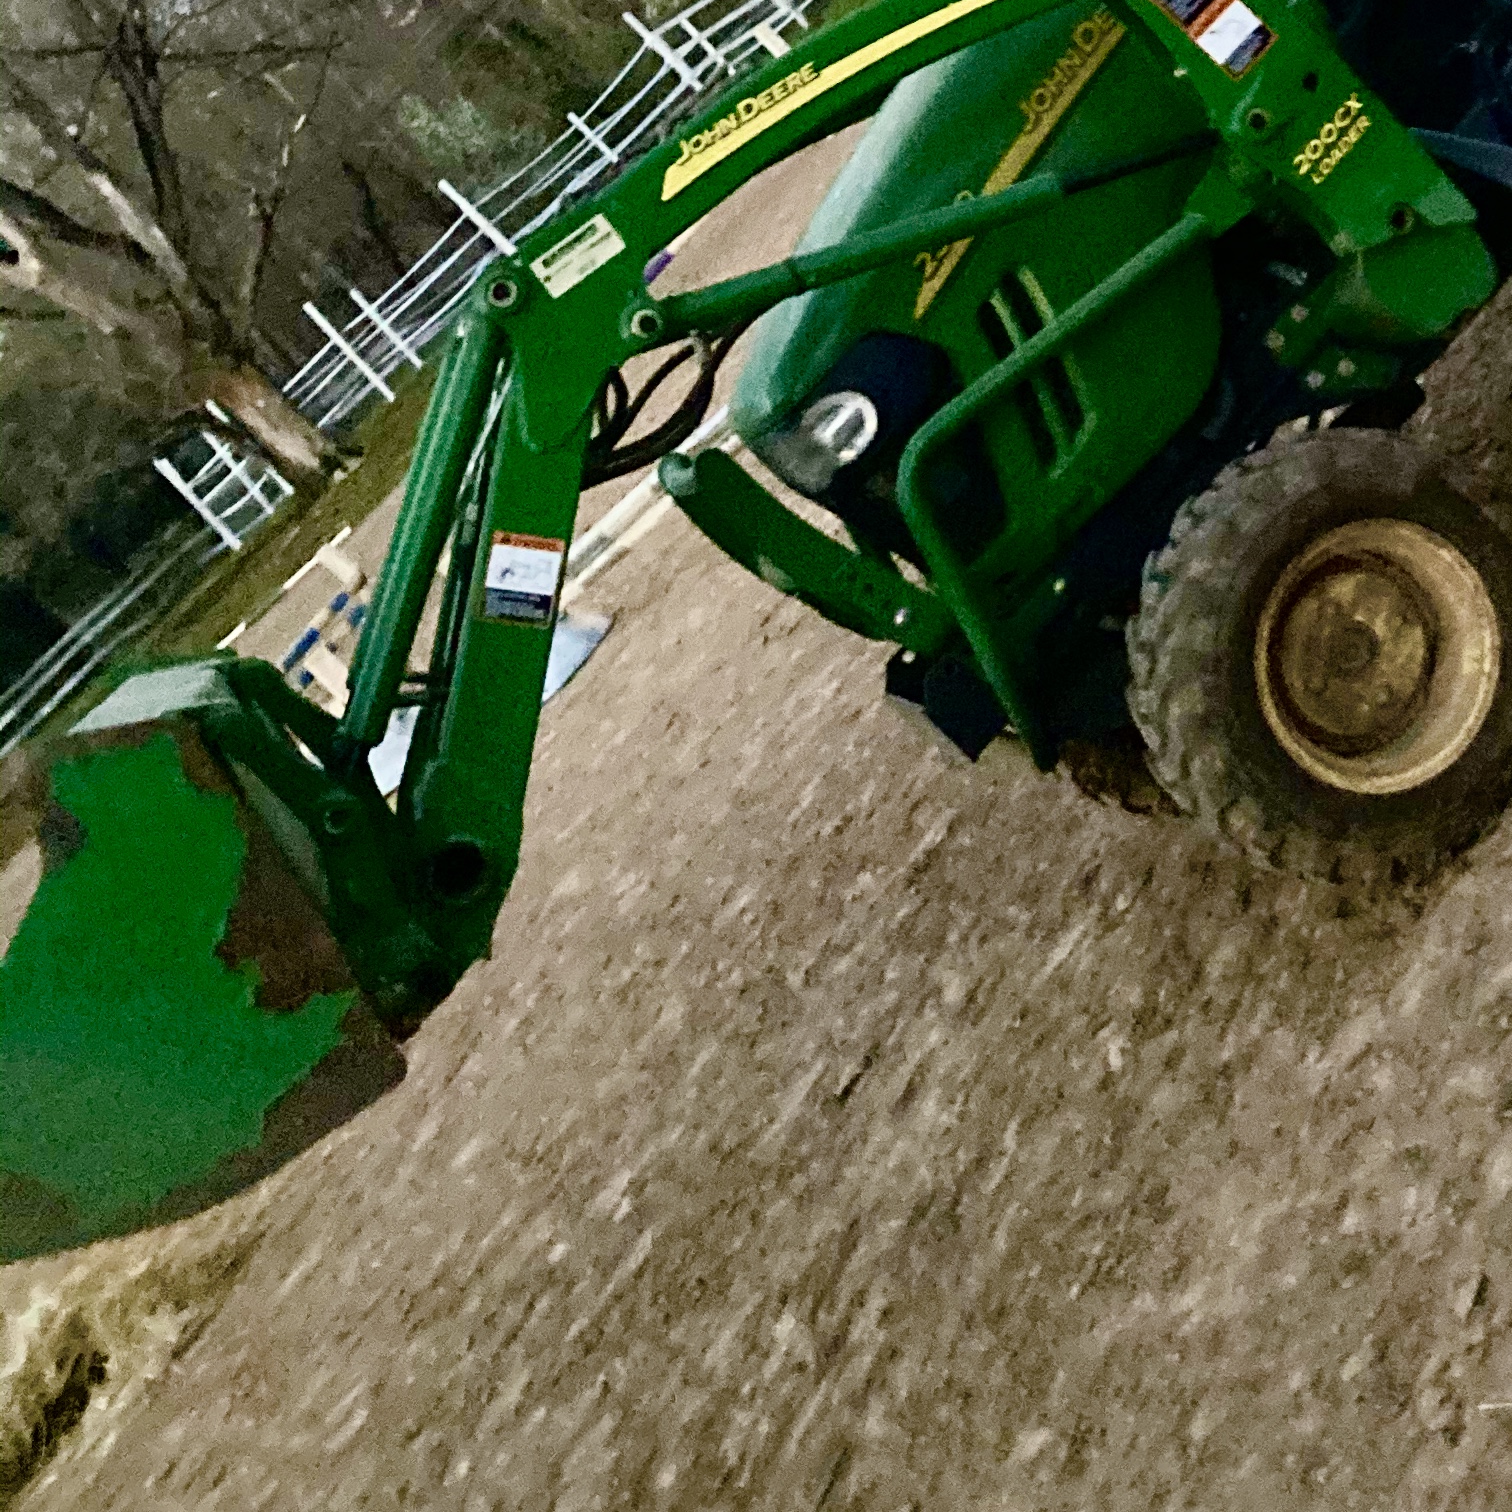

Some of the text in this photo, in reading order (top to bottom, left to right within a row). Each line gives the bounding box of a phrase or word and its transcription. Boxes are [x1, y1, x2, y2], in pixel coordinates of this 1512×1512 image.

[676, 61, 820, 165] JOHN DEERE
[1019, 47, 1081, 135] JOHN
[1293, 92, 1363, 175] 200CX
[1311, 115, 1372, 184] LOADER
